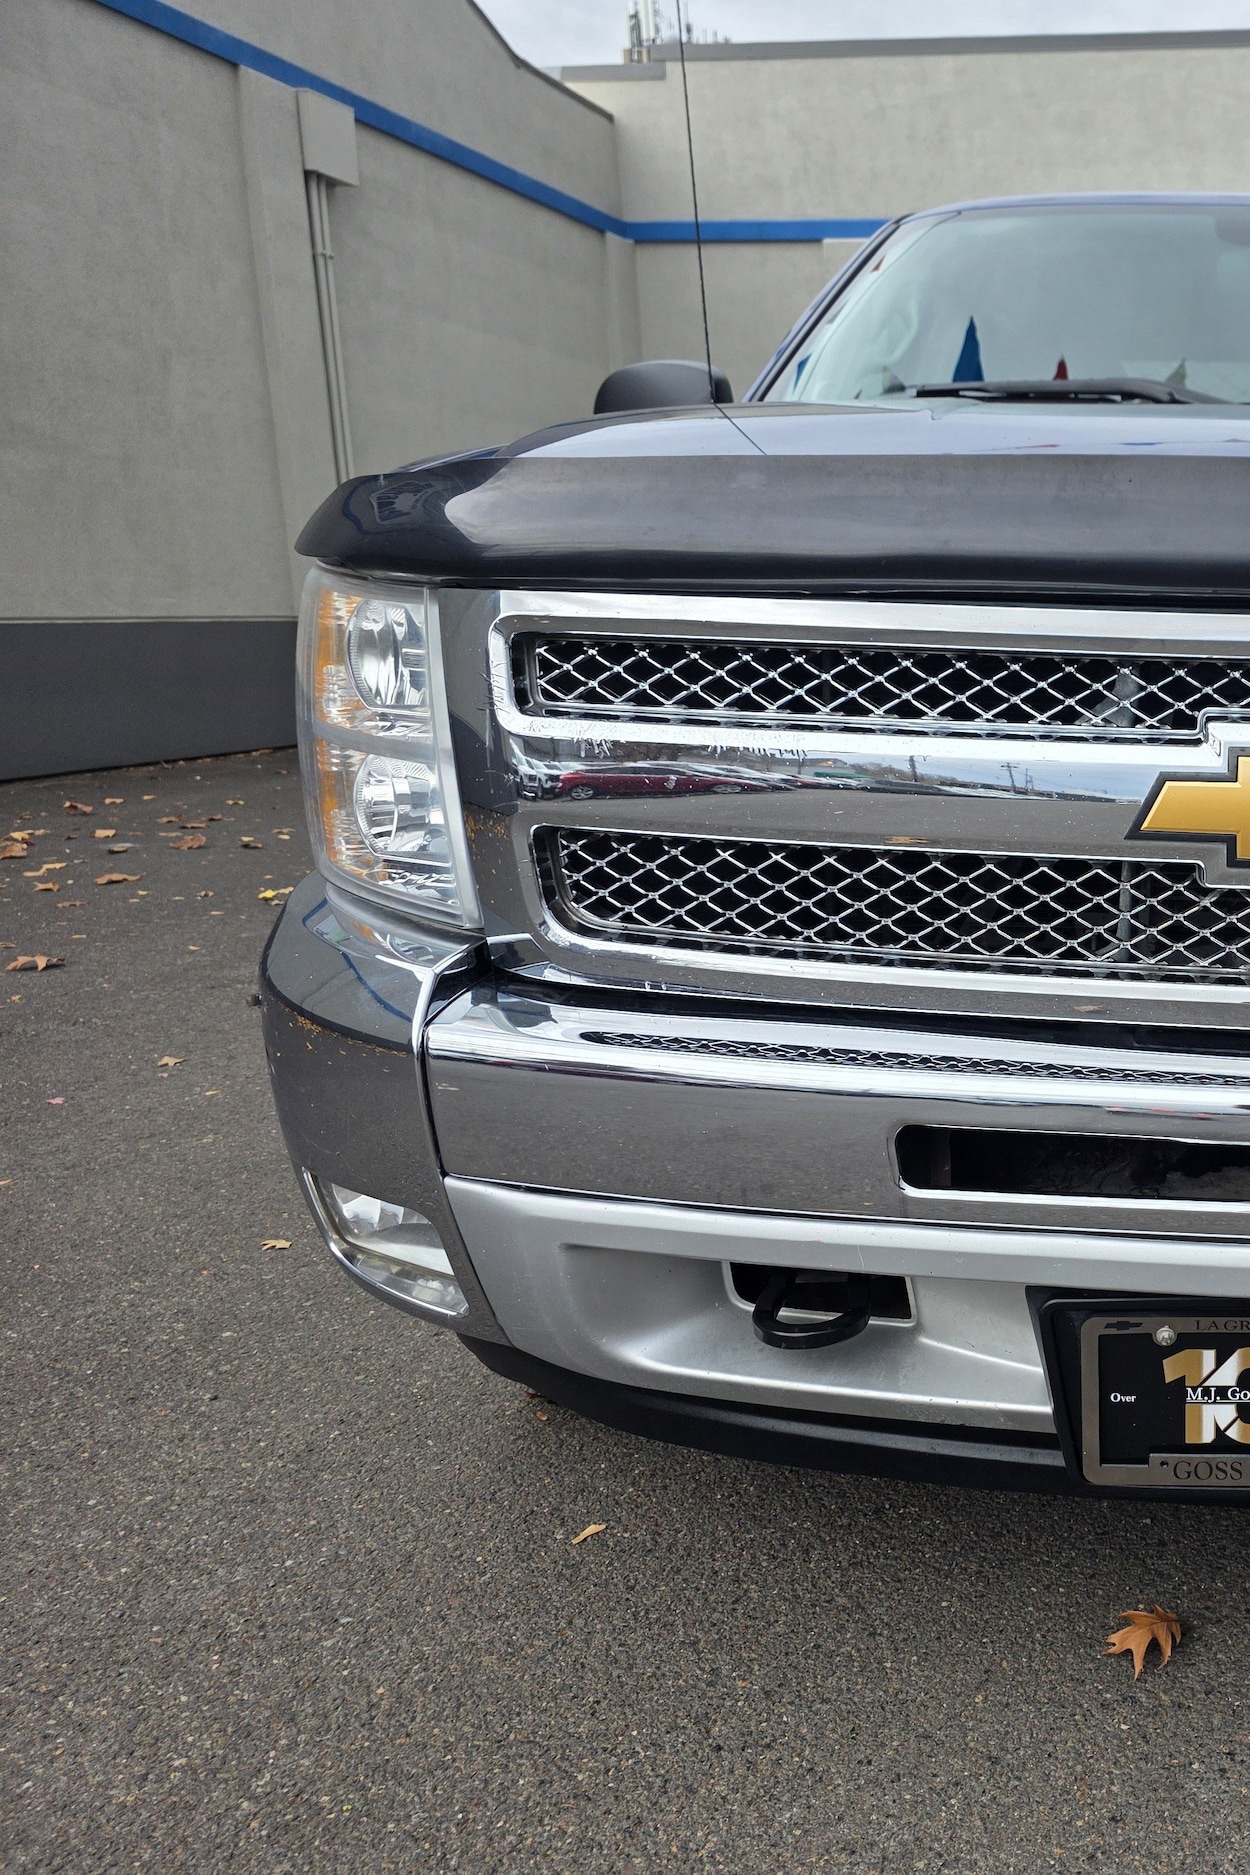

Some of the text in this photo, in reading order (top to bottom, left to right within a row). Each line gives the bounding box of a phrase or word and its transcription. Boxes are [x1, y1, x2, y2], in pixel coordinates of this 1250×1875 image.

[1110, 1392, 1136, 1403] Over
[1186, 1387, 1220, 1403] M.J.
[1172, 1460, 1243, 1481] GOSS
